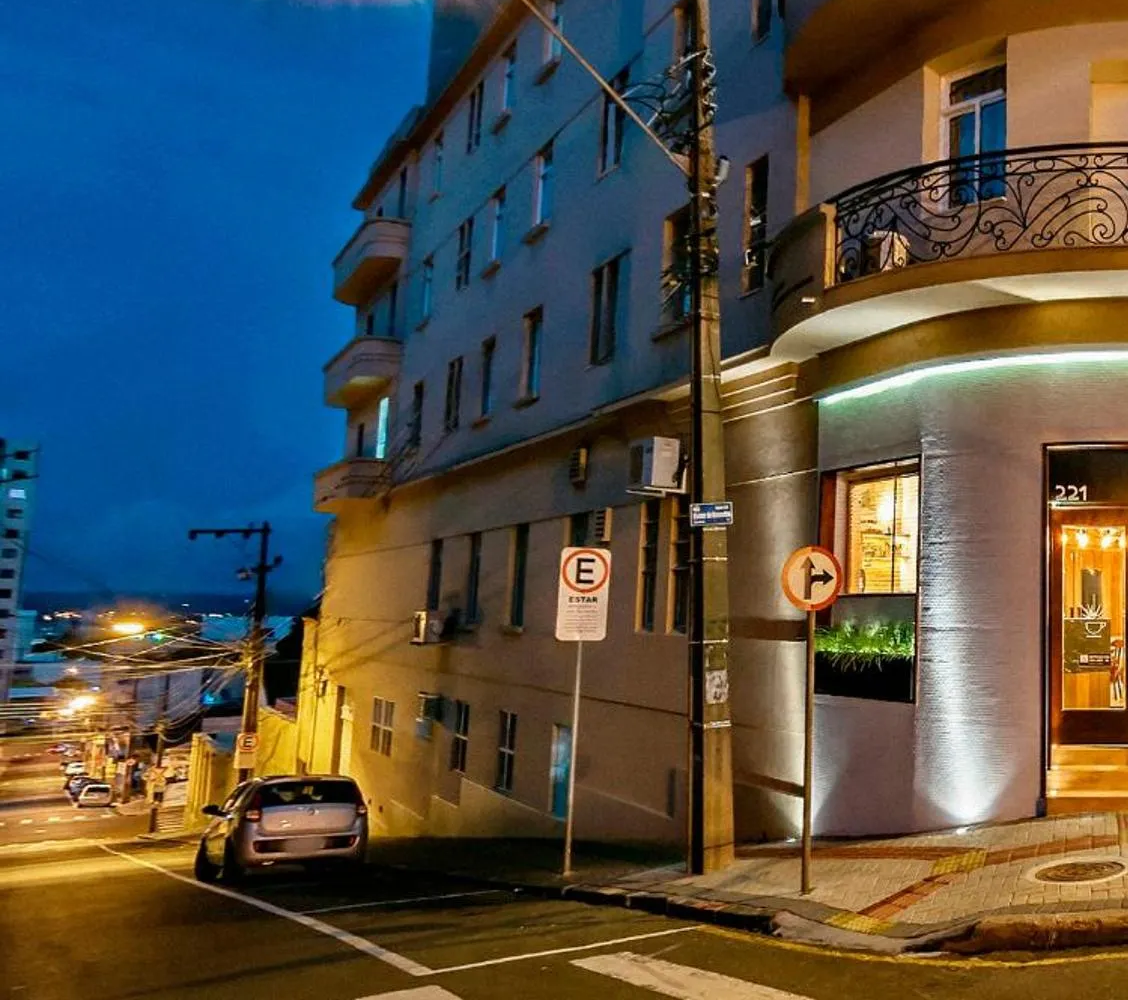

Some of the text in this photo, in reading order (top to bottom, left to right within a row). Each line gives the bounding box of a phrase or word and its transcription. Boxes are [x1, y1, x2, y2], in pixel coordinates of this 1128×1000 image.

[1055, 484, 1087, 501] 221
[576, 558, 595, 583] E
[244, 736, 253, 748] E
